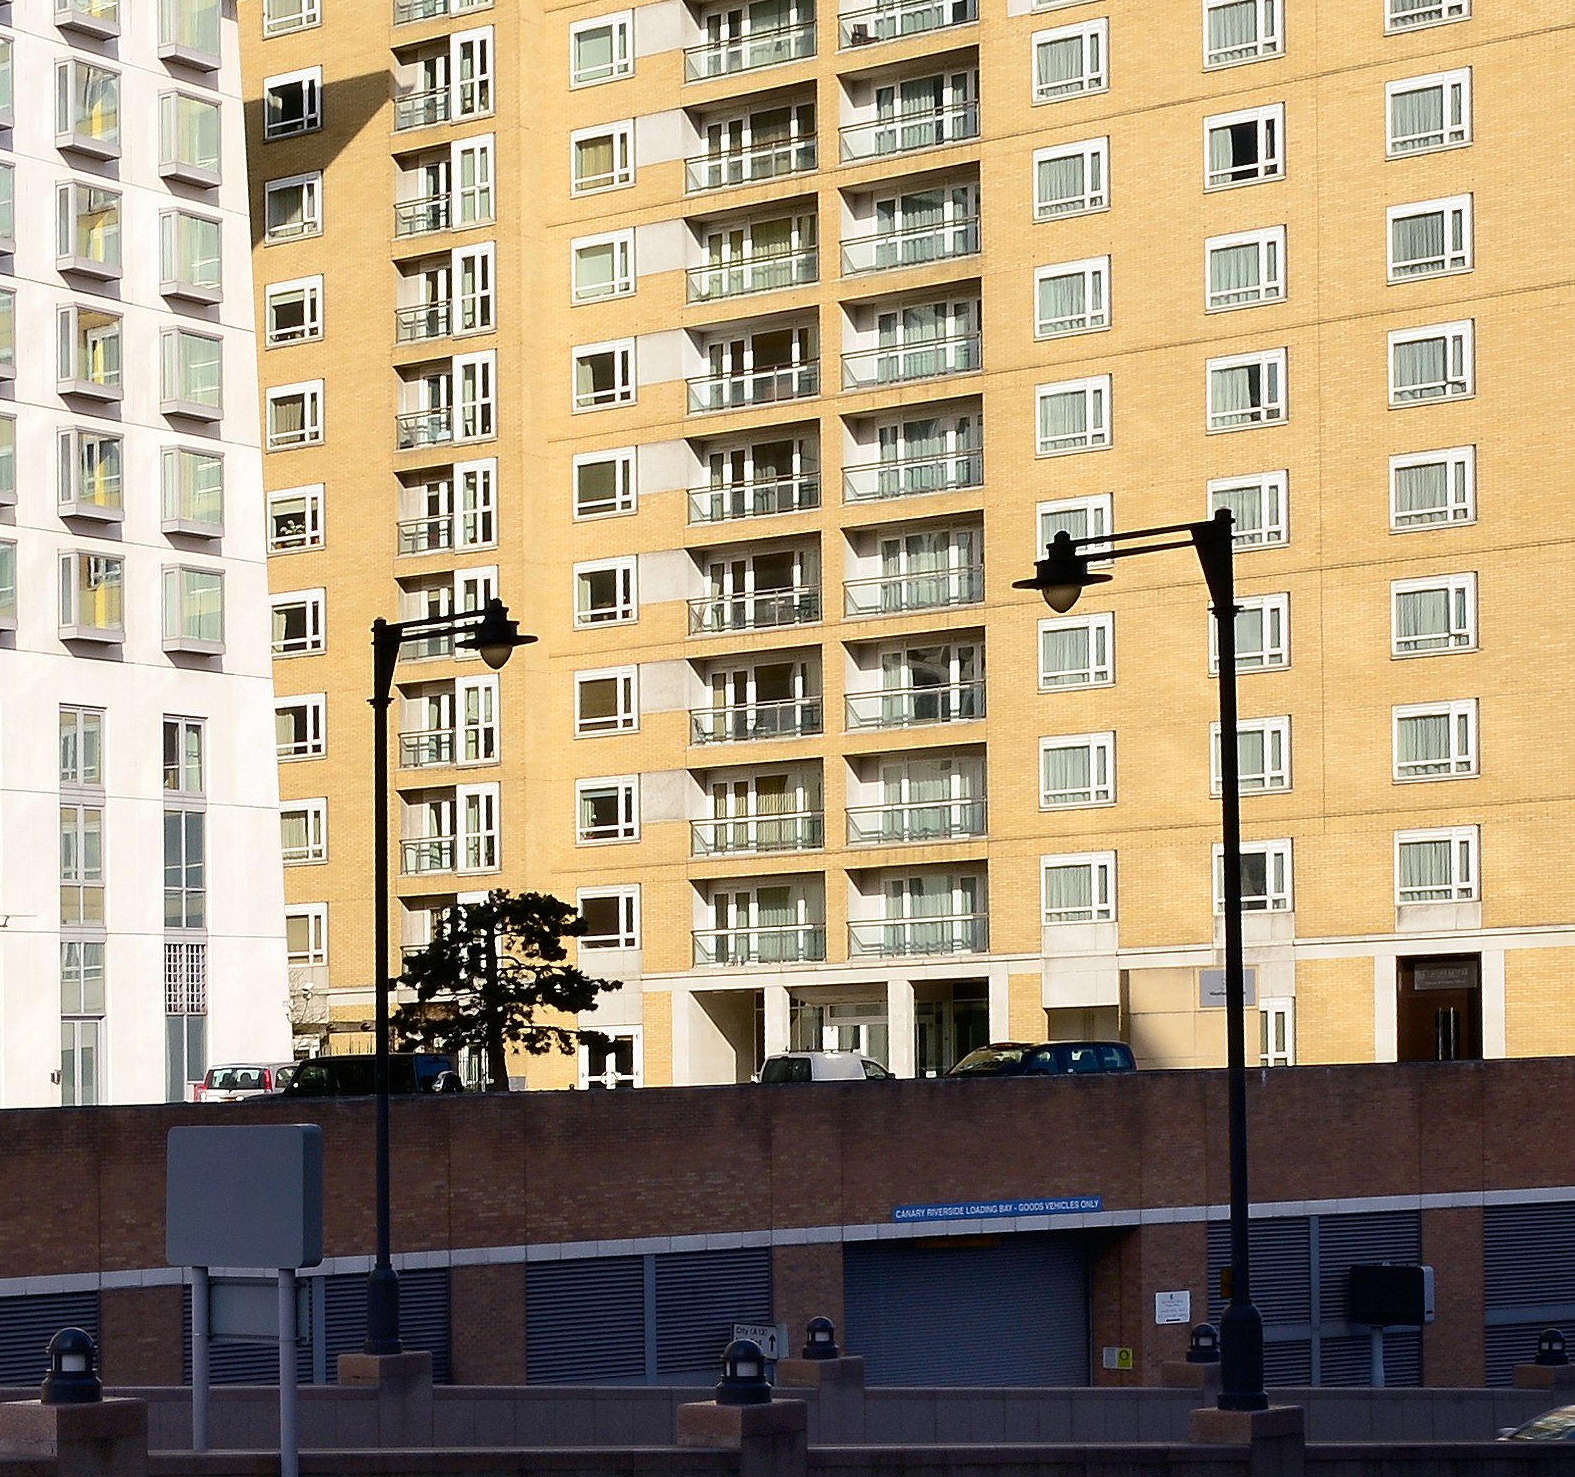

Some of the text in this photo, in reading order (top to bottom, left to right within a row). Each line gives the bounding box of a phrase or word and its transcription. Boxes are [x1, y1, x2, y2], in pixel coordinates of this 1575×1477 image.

[895, 1208, 926, 1218] CANARY
[927, 1206, 964, 1217] RIVERSIDE
[966, 1204, 998, 1215] LOADING
[999, 1204, 1012, 1214] BAY
[1018, 1202, 1044, 1212] GOODS
[1045, 1200, 1079, 1210] VEHICLES
[1080, 1199, 1099, 1209] ONLY
[736, 1327, 748, 1335] City
